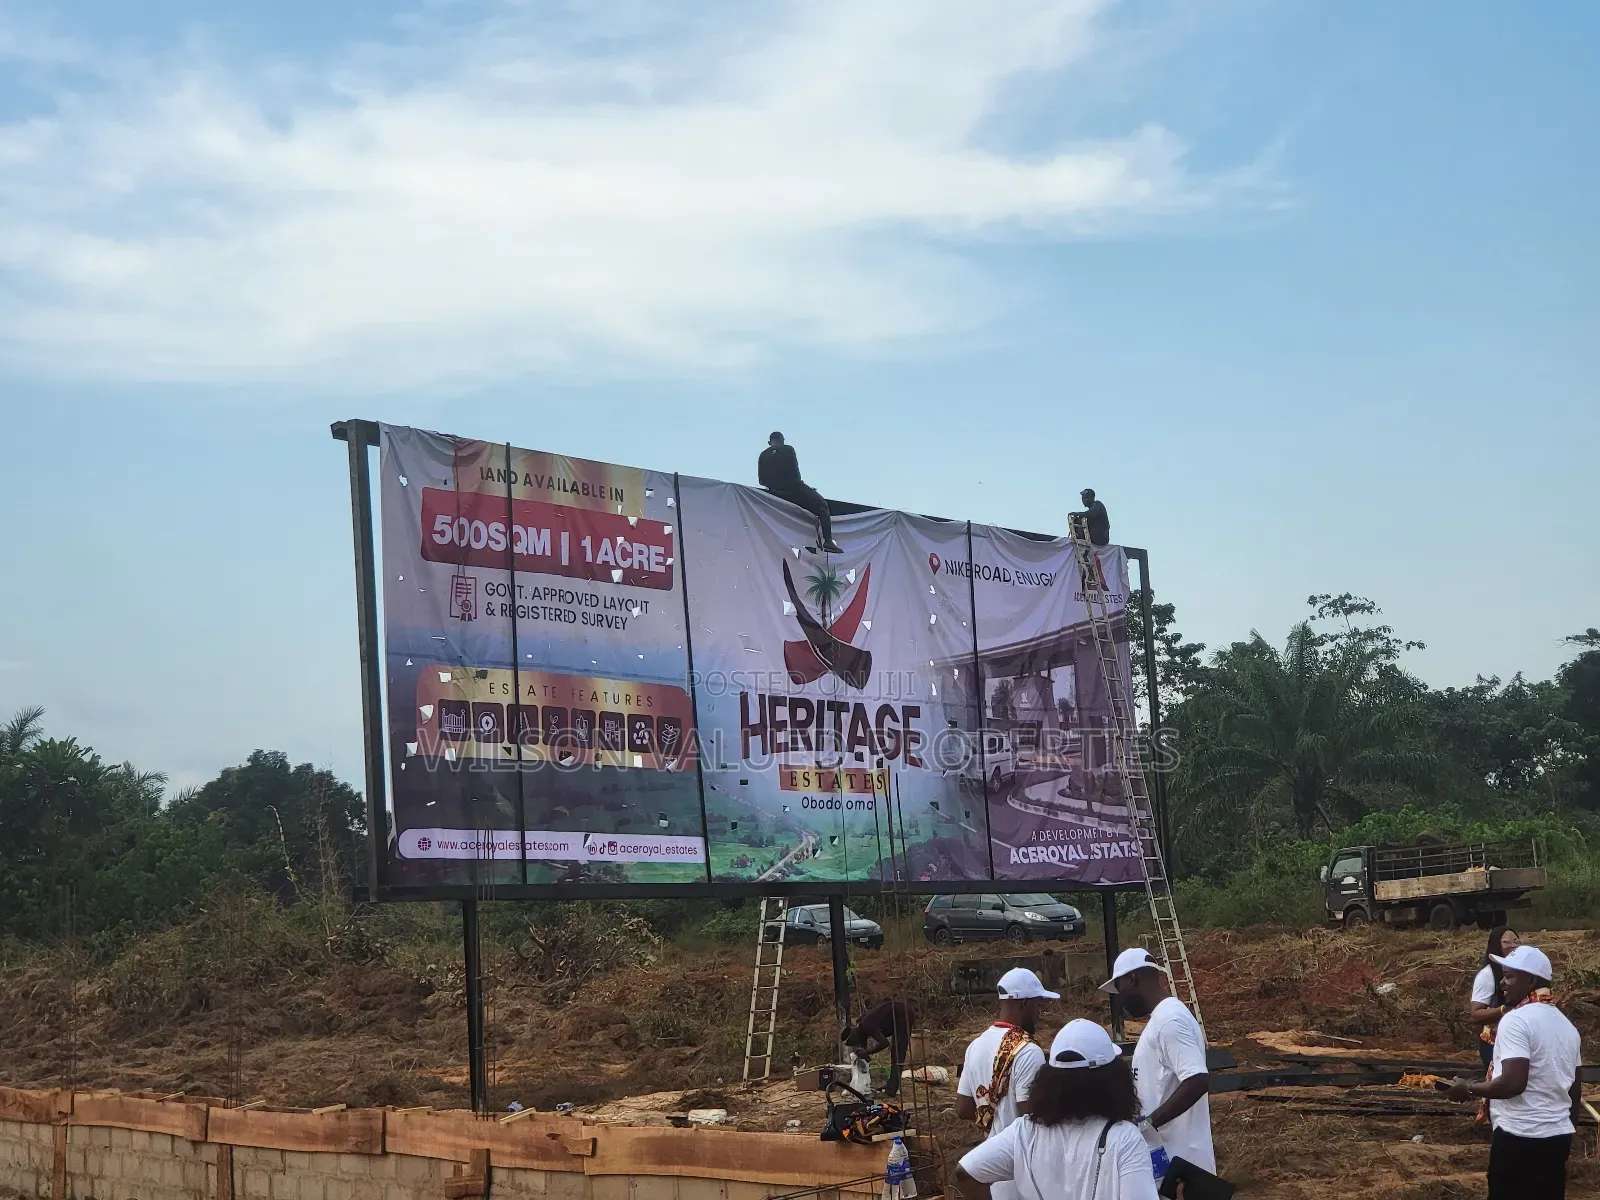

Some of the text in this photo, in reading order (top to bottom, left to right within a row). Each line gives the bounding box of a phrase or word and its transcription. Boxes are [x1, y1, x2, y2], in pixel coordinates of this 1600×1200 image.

[523, 472, 606, 500] AVAILABLE
[609, 486, 625, 503] IN
[431, 514, 553, 557] 500SQM
[581, 535, 667, 573] 1ACRE
[944, 558, 972, 579] NIKE
[974, 563, 1016, 587] ROAD,
[531, 586, 600, 608] APPROVED
[485, 602, 497, 617] &
[581, 611, 629, 631] SURVEY
[488, 682, 654, 708] ESATE FEATURES
[739, 690, 924, 768] HERITAGE
[789, 770, 885, 791] ESTATES
[801, 796, 875, 811] Obodo oma
[1030, 830, 1037, 842] A
[1107, 825, 1121, 838] BY
[619, 843, 699, 856] aceroyal_estates
[1008, 843, 1089, 866] ACEROYAL
